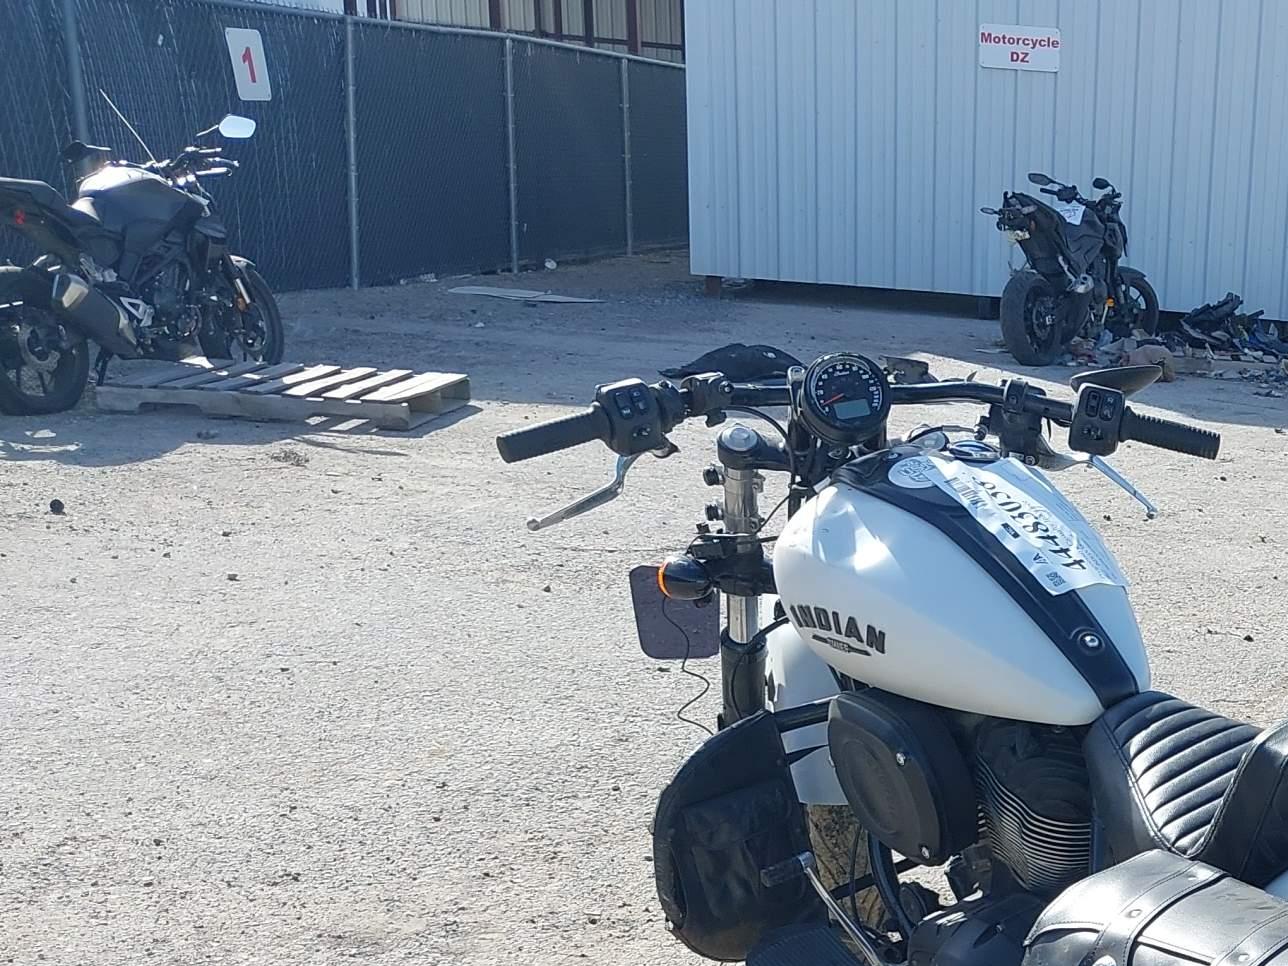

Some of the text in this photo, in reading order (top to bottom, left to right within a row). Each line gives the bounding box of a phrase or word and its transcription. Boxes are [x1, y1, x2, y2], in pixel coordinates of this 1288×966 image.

[980, 31, 1060, 49] Motorcycle
[242, 46, 257, 83] 1
[1010, 51, 1030, 63] DZ
[789, 604, 886, 655] INDIAN
